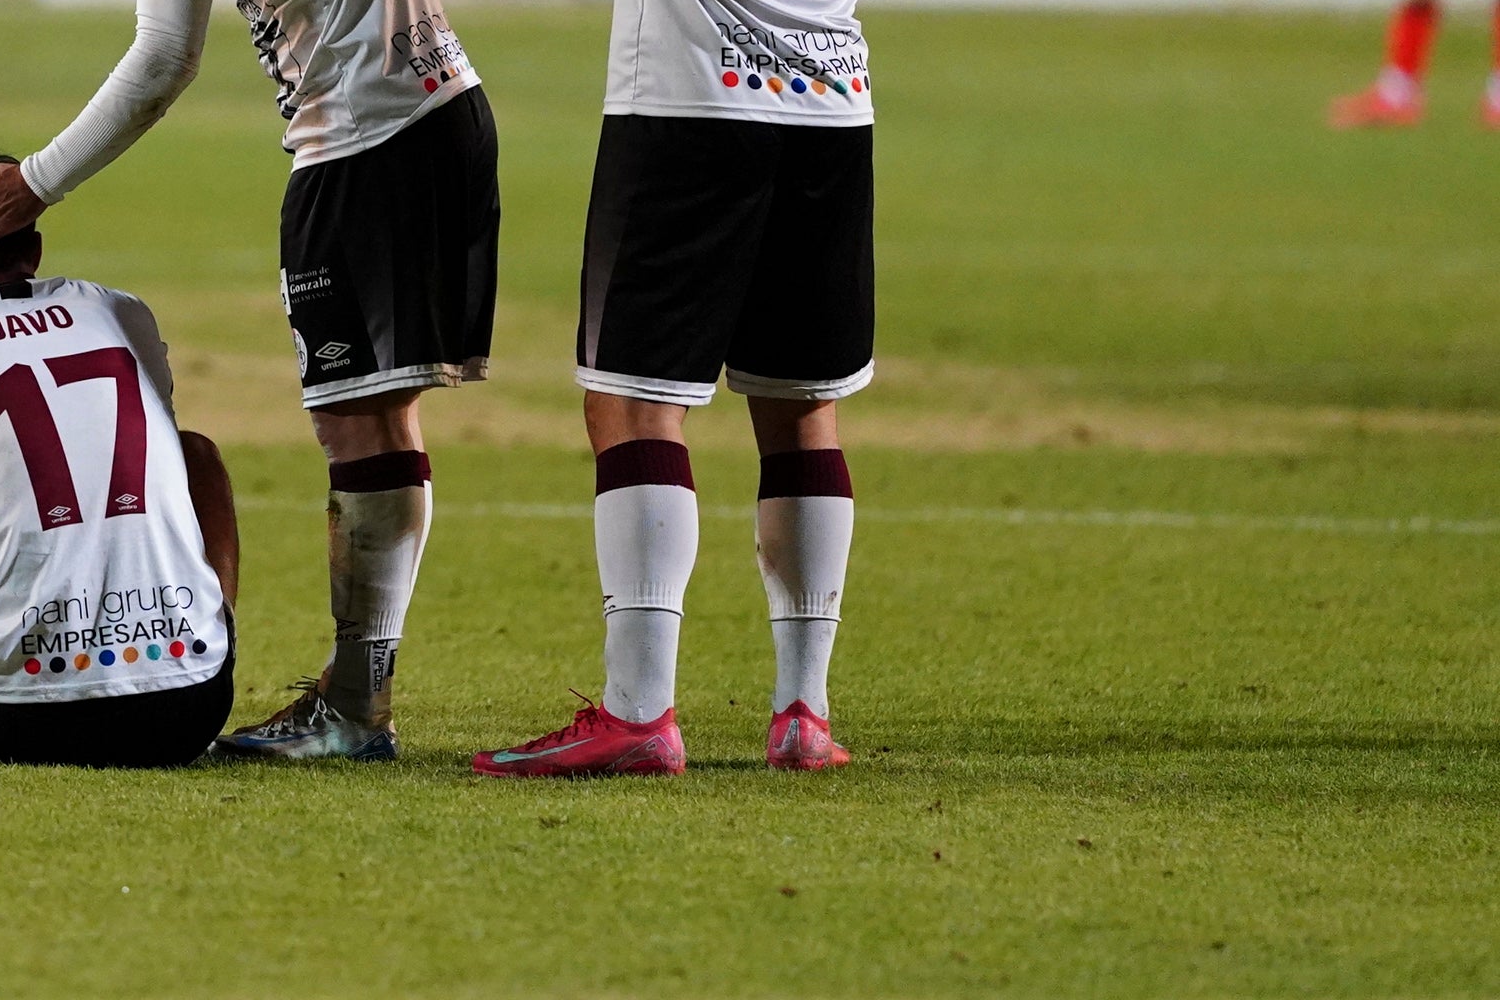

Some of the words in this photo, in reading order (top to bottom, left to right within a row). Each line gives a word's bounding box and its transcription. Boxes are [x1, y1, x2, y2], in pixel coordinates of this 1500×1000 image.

[721, 47, 867, 77] EMPRESARIAL
[290, 276, 331, 294] Gonzalo
[321, 357, 350, 371] umbro
[22, 588, 89, 629] nani
[102, 584, 194, 623] grupo
[20, 616, 195, 655] EMPRESARIA
